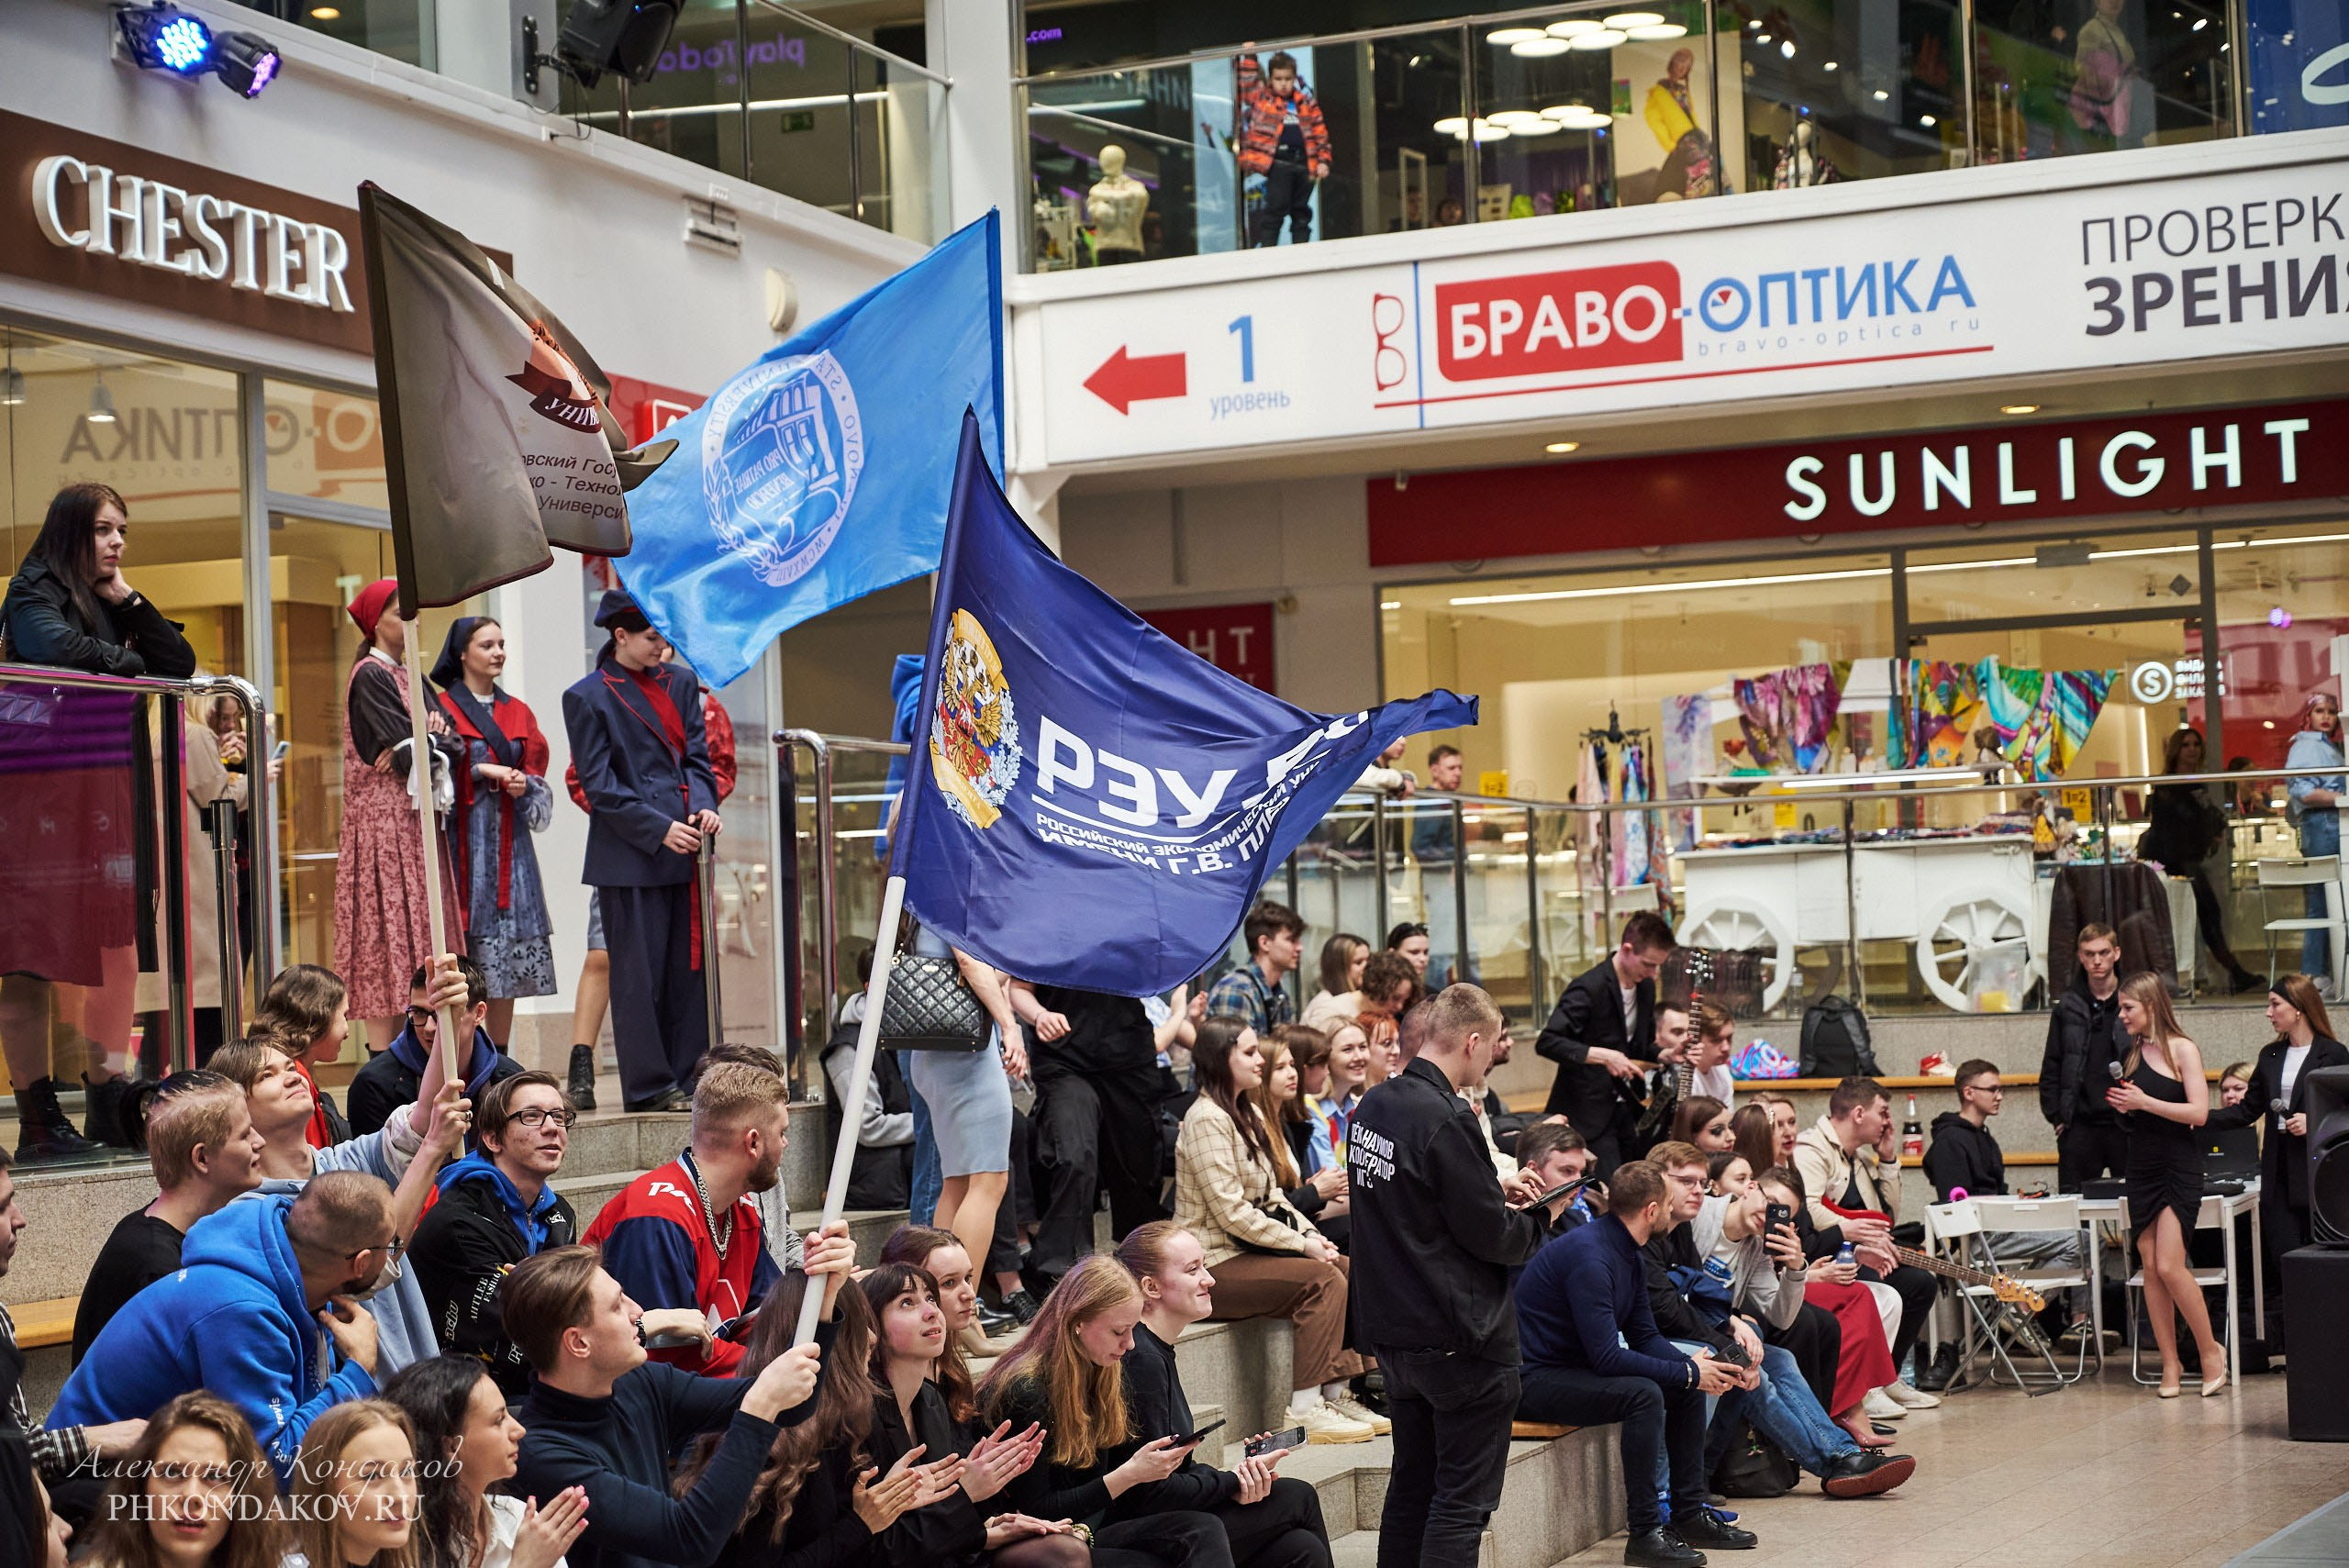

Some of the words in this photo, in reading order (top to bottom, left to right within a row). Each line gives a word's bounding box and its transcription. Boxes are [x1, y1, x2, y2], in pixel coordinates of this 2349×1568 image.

[32, 154, 355, 313] CHESTER
[2082, 192, 2349, 265] ПРОВЕРК
[2084, 254, 2349, 336] ЗРЕНИ
[1229, 315, 1253, 382] 1
[1209, 390, 1291, 421] уровень
[1784, 418, 2310, 521] SUNLIGHT
[1036, 812, 1150, 856] РОССИЙСКИЙ
